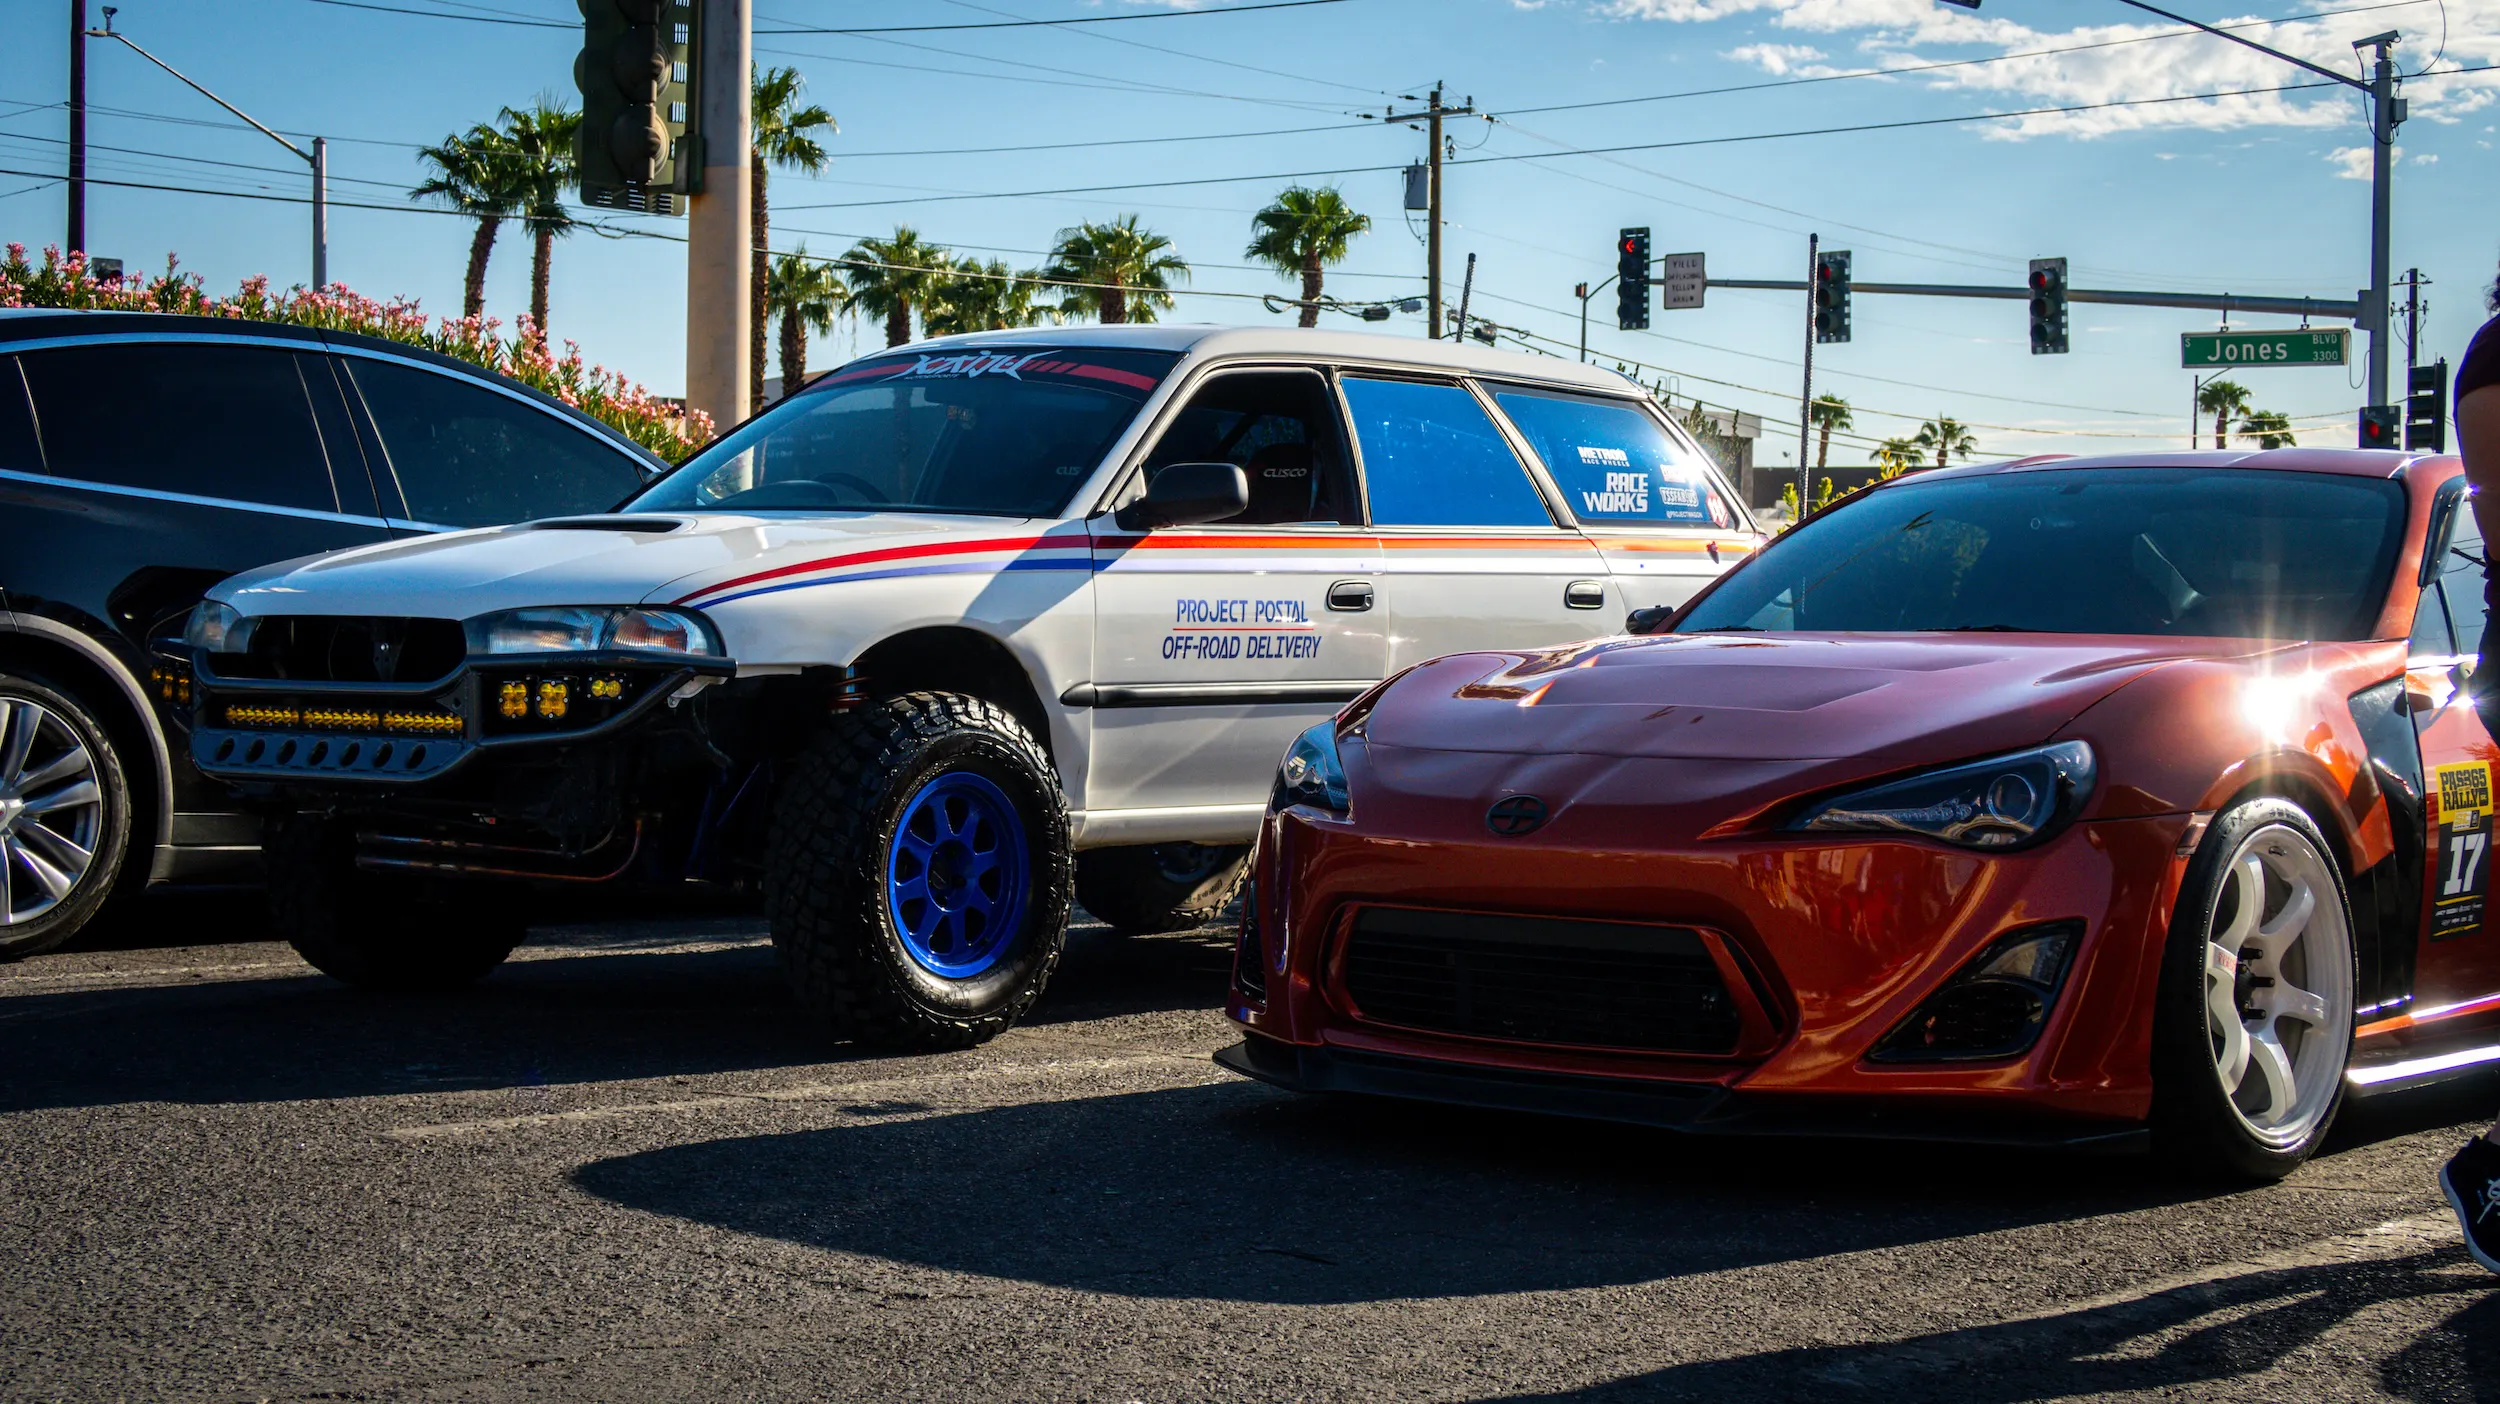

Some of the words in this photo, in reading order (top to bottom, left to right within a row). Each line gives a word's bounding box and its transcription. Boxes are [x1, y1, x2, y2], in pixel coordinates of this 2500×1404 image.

[1672, 259, 1697, 268] YIELD
[1671, 283, 1696, 292] YELLOW
[2185, 338, 2191, 348] S
[2207, 339, 2288, 361] Jones
[2313, 334, 2338, 345] BLVD
[2313, 351, 2338, 361] 3300
[1577, 446, 1628, 461] METHOD
[1055, 465, 1083, 476] CUS
[1601, 459, 1630, 467] WHEELS
[1263, 467, 1307, 479] CUSCO
[1605, 472, 1648, 492] RACE
[1582, 492, 1648, 512] WORKS
[1176, 599, 1248, 623] PROJECT
[1255, 600, 1309, 623] POSTAL
[1162, 636, 1241, 659] OFF-ROAD
[1246, 635, 1322, 659] DELIVERY
[2442, 787, 2479, 811] RALLY
[2443, 832, 2487, 895] 17
